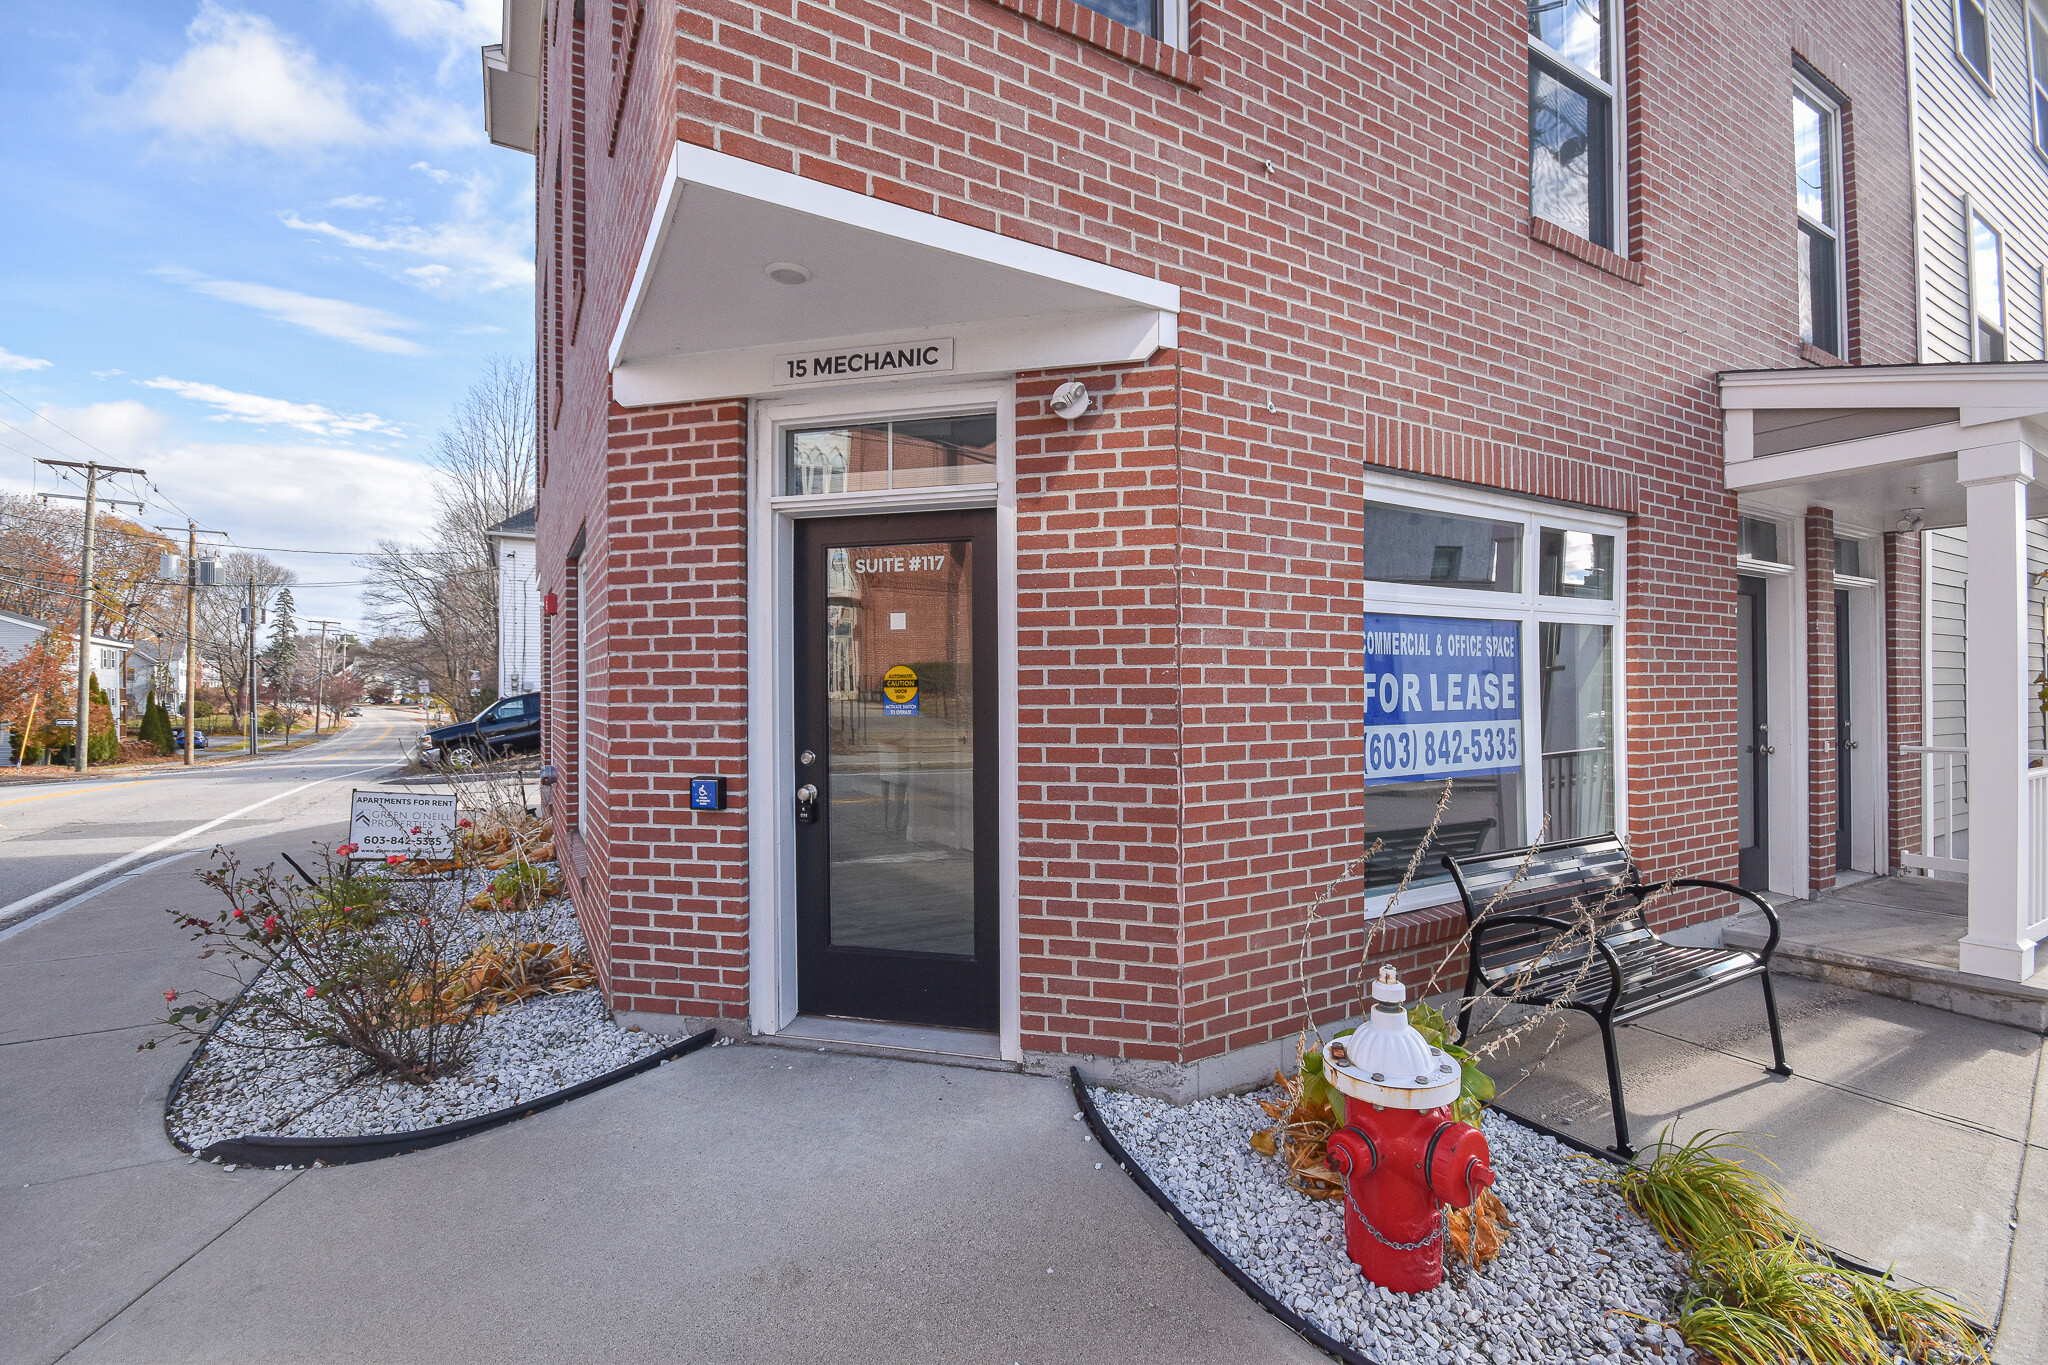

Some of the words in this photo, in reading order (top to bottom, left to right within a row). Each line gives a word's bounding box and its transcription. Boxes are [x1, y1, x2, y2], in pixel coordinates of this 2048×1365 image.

[787, 359, 807, 378] 15
[813, 346, 939, 376] MECHANIC
[855, 557, 904, 574] SUITE
[909, 555, 945, 571] #117
[1436, 634, 1443, 656] &
[1448, 634, 1482, 657] OFFICE
[1486, 635, 1515, 658] SPACE
[1364, 672, 1422, 713] FOR
[1430, 673, 1515, 711] LEASE
[1364, 730, 1418, 774] (603)
[1425, 727, 1517, 766] 842-5335
[356, 797, 412, 805] APARTMENTS
[371, 810, 408, 819] GREEN
[364, 836, 442, 846] 603-842-5335
